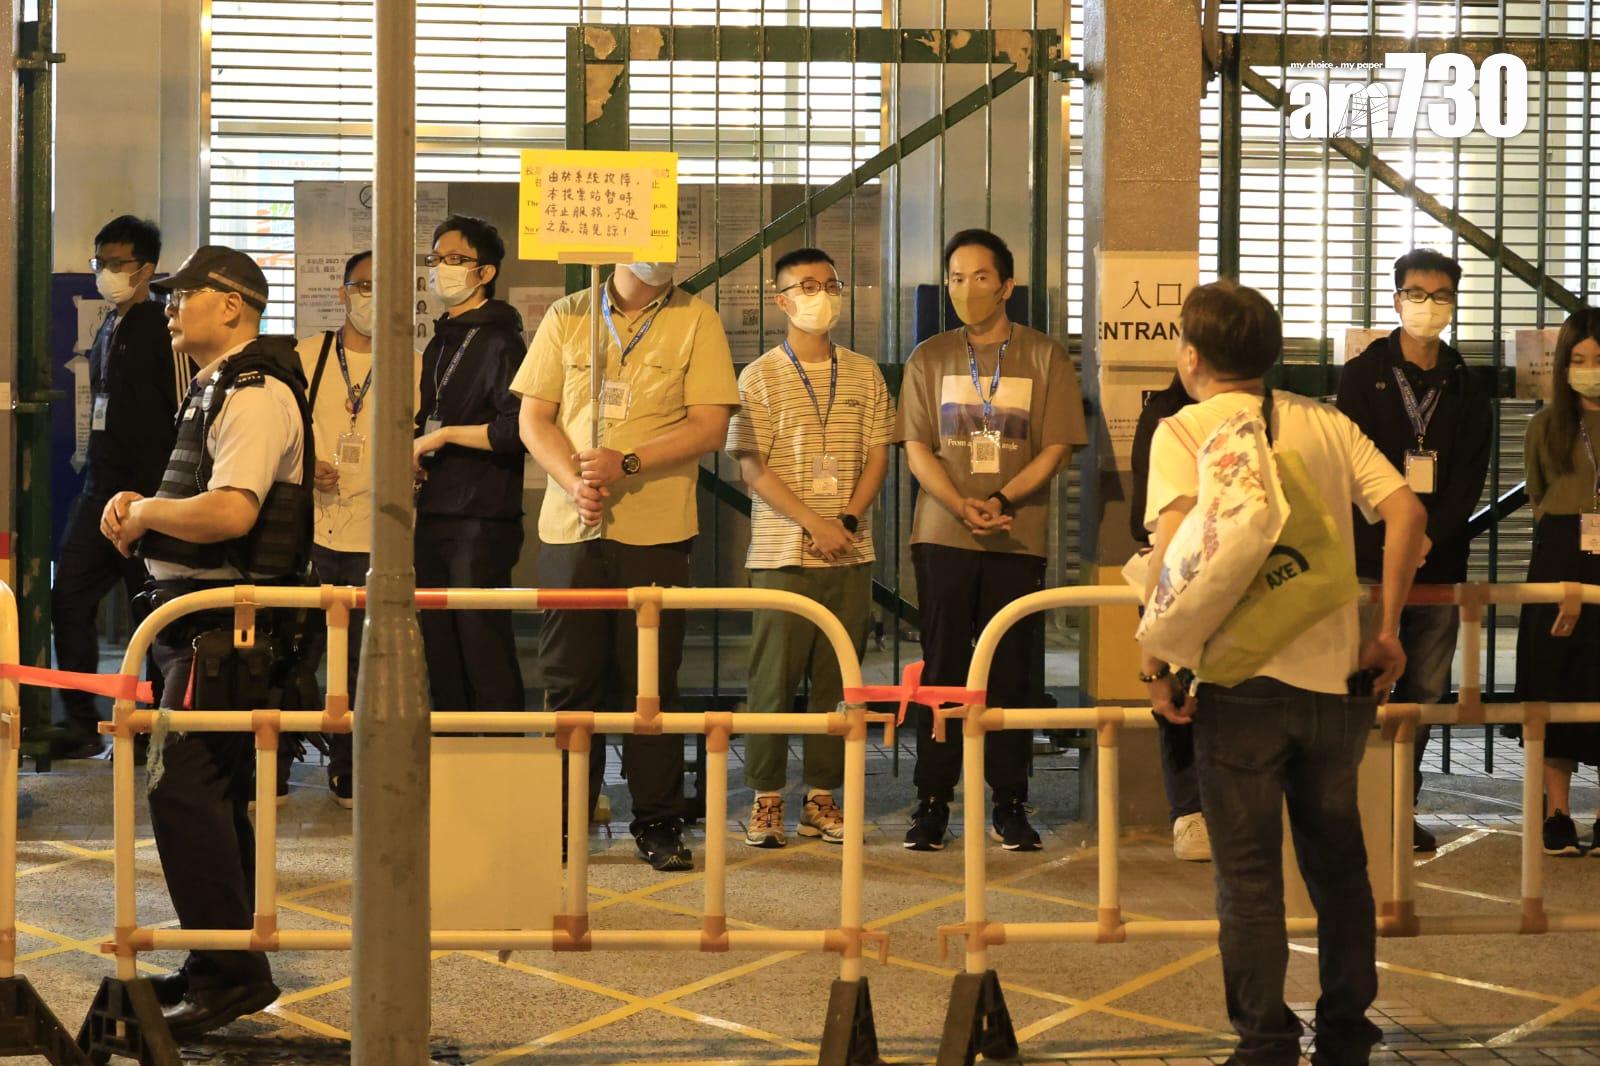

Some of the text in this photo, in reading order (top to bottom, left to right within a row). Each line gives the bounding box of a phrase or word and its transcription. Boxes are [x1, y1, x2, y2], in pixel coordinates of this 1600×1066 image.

[547, 187, 633, 206] 本投票站暫時
[1121, 280, 1183, 309] 入口
[1098, 321, 1181, 340] NTRAN
[1265, 561, 1298, 590] AXE
